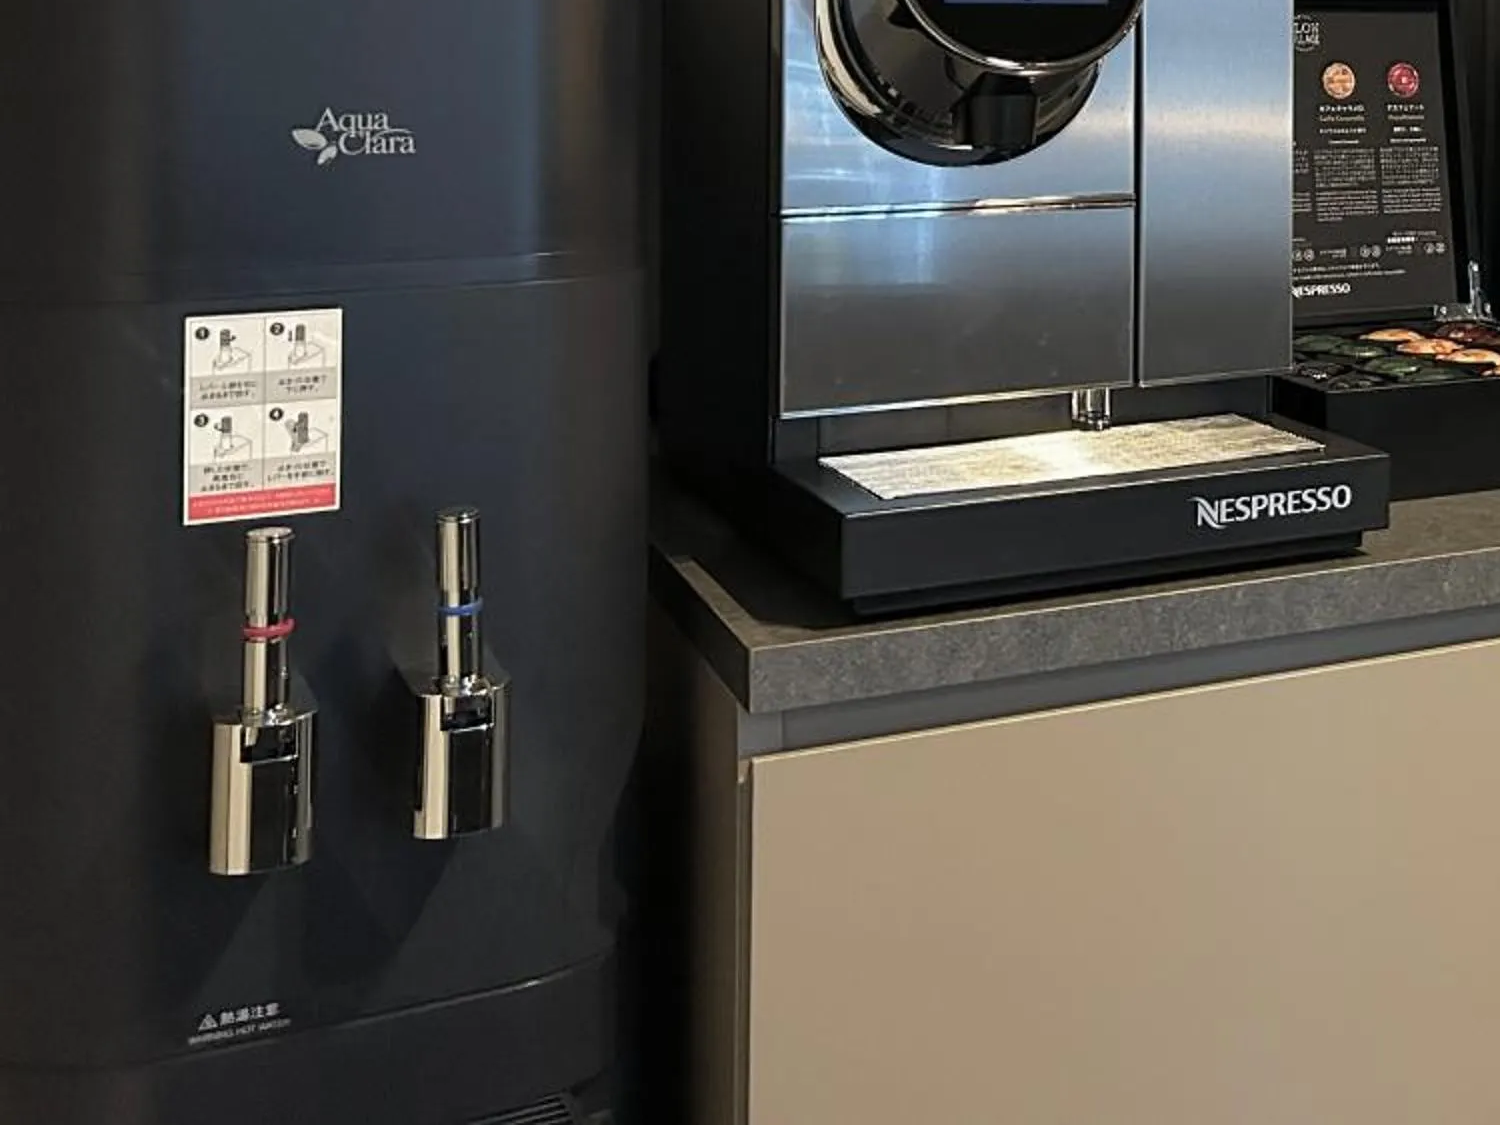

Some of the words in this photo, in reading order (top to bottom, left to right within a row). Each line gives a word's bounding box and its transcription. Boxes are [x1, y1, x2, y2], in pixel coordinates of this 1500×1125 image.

[315, 106, 389, 137] Aqua
[337, 129, 416, 155] Clara
[1187, 484, 1352, 530] NESPRESSO
